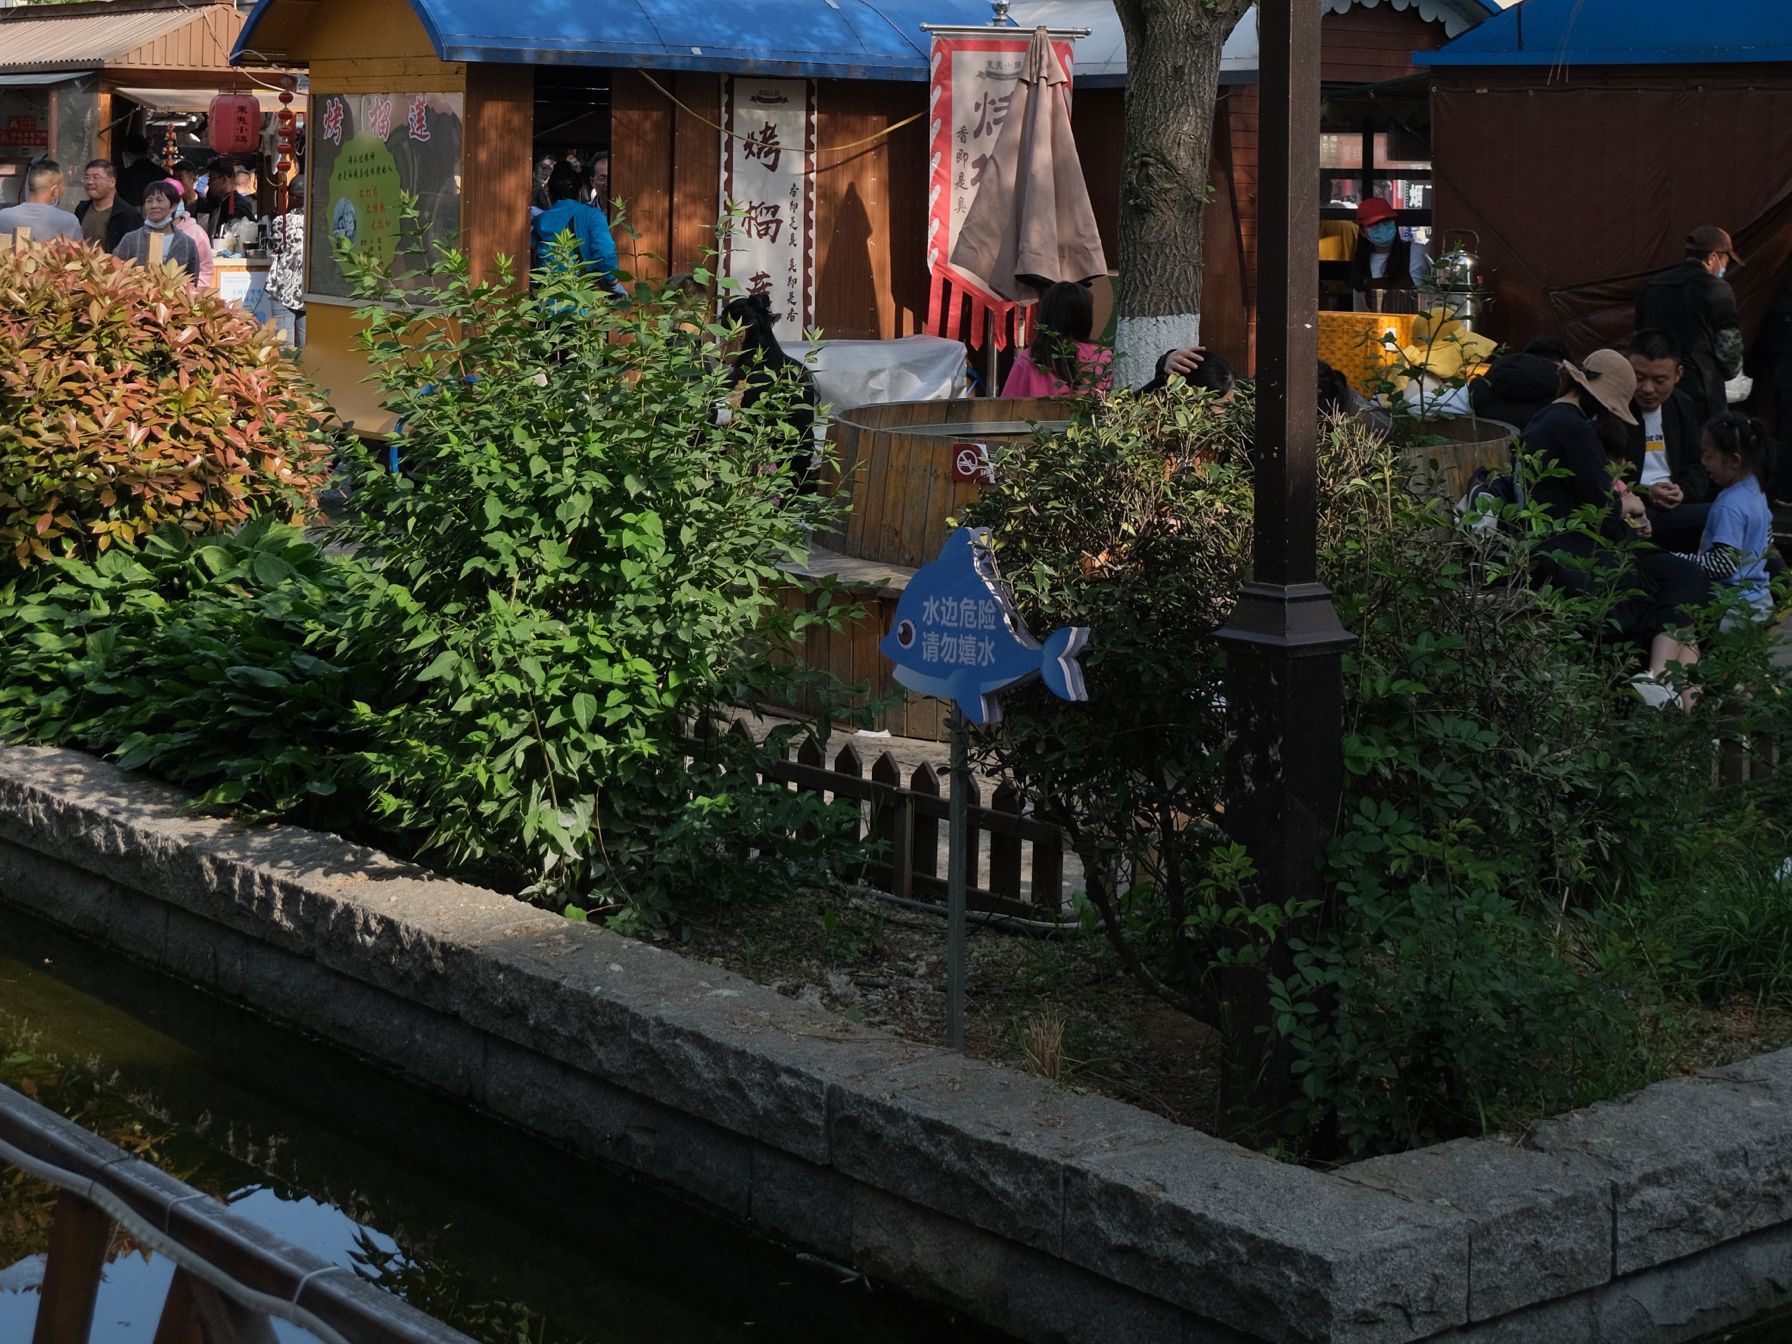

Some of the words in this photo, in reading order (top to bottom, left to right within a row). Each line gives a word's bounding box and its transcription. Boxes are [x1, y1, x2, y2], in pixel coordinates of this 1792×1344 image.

[922, 595, 996, 630] 水边危险
[921, 631, 996, 667] 请勿嬉水
